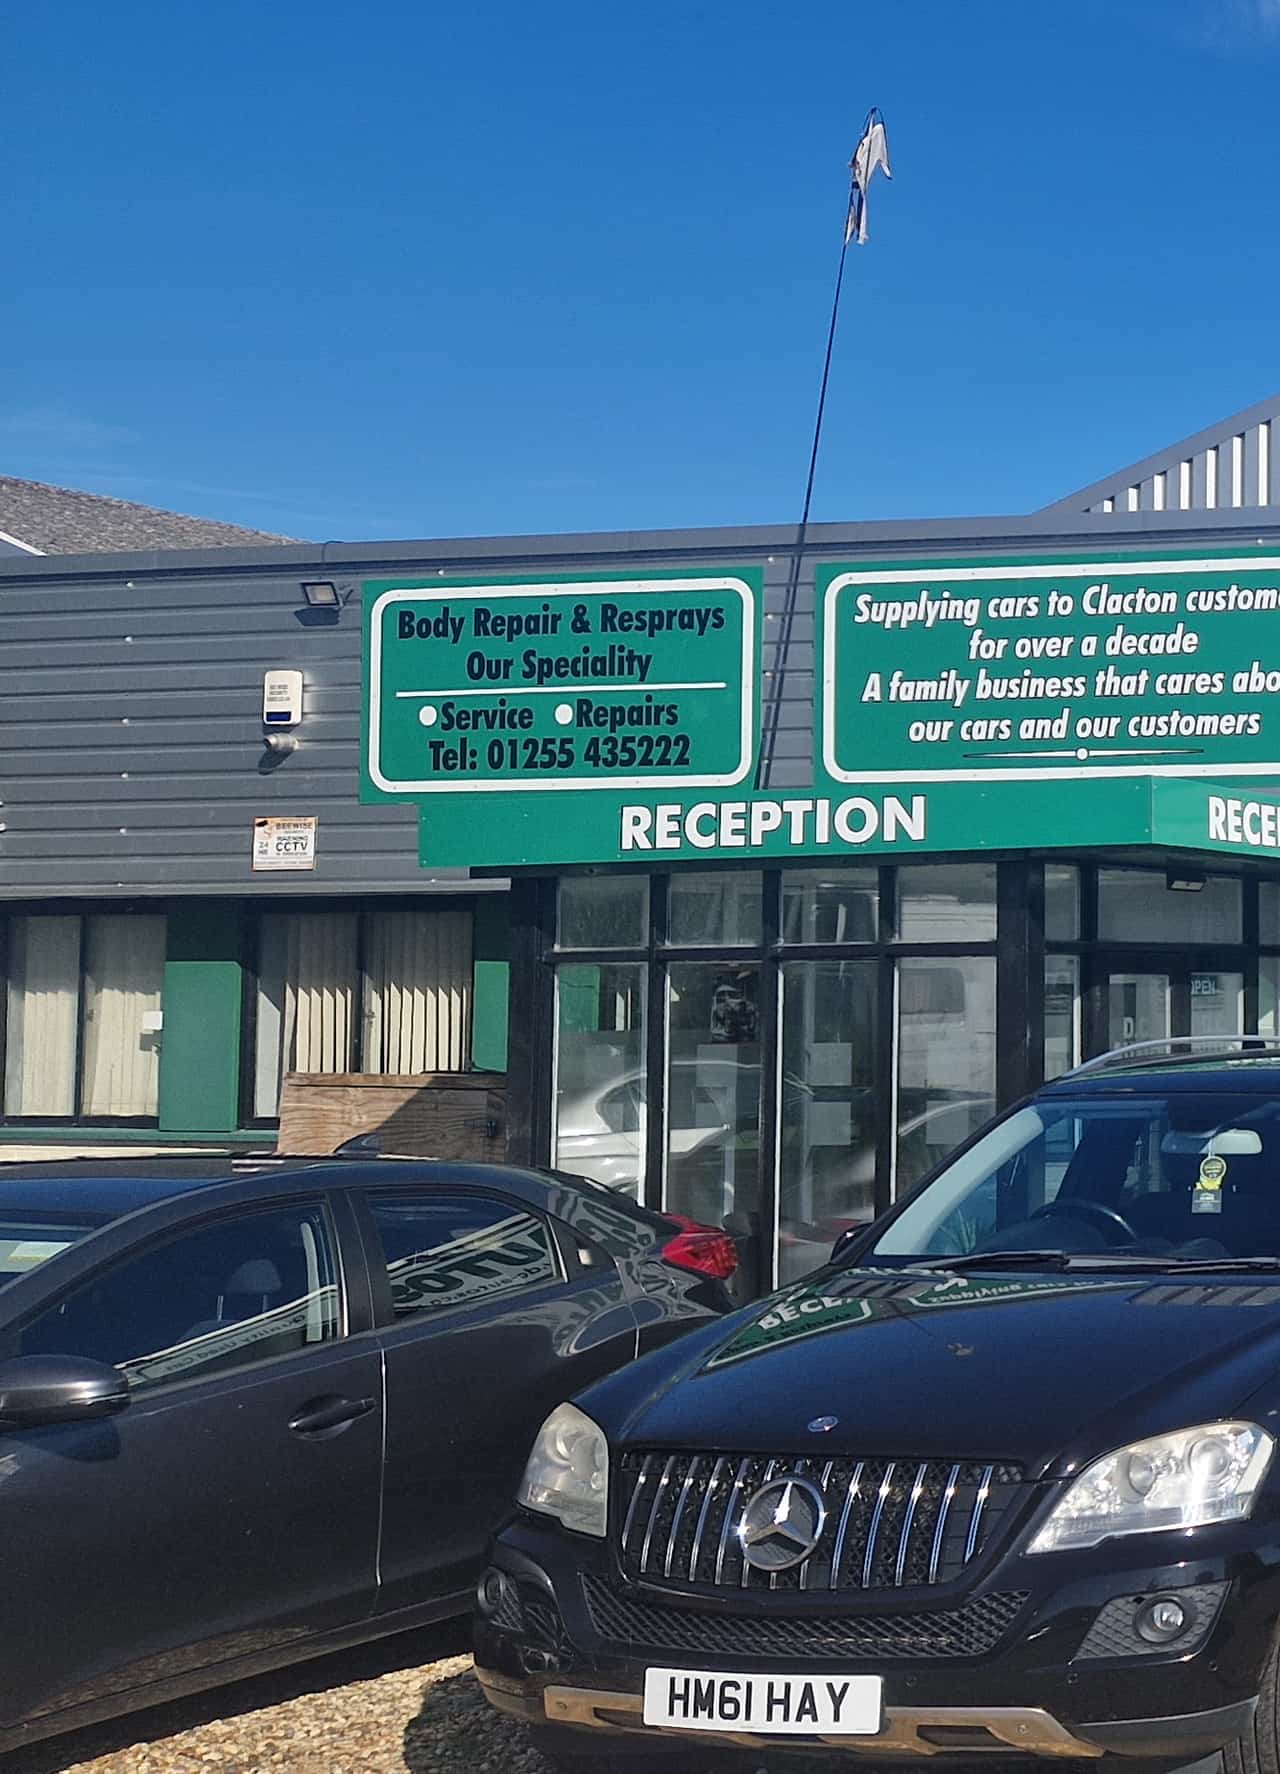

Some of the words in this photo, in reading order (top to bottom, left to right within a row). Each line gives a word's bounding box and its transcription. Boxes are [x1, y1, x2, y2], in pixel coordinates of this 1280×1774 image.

[398, 606, 465, 643] Body
[473, 603, 562, 642] Repair
[570, 604, 592, 634] &
[600, 602, 725, 637] Resprays
[854, 588, 981, 629] Supplying
[987, 593, 1039, 619] cars
[1047, 588, 1073, 616] to
[1082, 583, 1179, 616] Clacton
[968, 628, 1008, 661] for
[1013, 631, 1075, 658] over
[1080, 632, 1098, 657] a
[1104, 623, 1199, 656] decade
[467, 650, 514, 681] Our
[521, 644, 652, 685] Speciality
[861, 672, 884, 704] A
[888, 670, 970, 707] family
[975, 668, 1086, 700] business
[1095, 665, 1149, 697] that
[1154, 671, 1225, 695] cares
[440, 698, 534, 731] Service
[575, 694, 679, 732] Repairs
[907, 718, 954, 744] our
[959, 717, 1012, 742] cars
[1018, 708, 1071, 740] and
[1075, 713, 1123, 738] our
[1127, 708, 1262, 738] customers
[428, 736, 477, 771] Tel:
[486, 736, 575, 770] 01255
[583, 734, 690, 768] 435222
[619, 795, 926, 851] RECEPTION
[275, 841, 308, 852] CCTV
[668, 1676, 754, 1722] HM61
[766, 1682, 850, 1723] HAY
